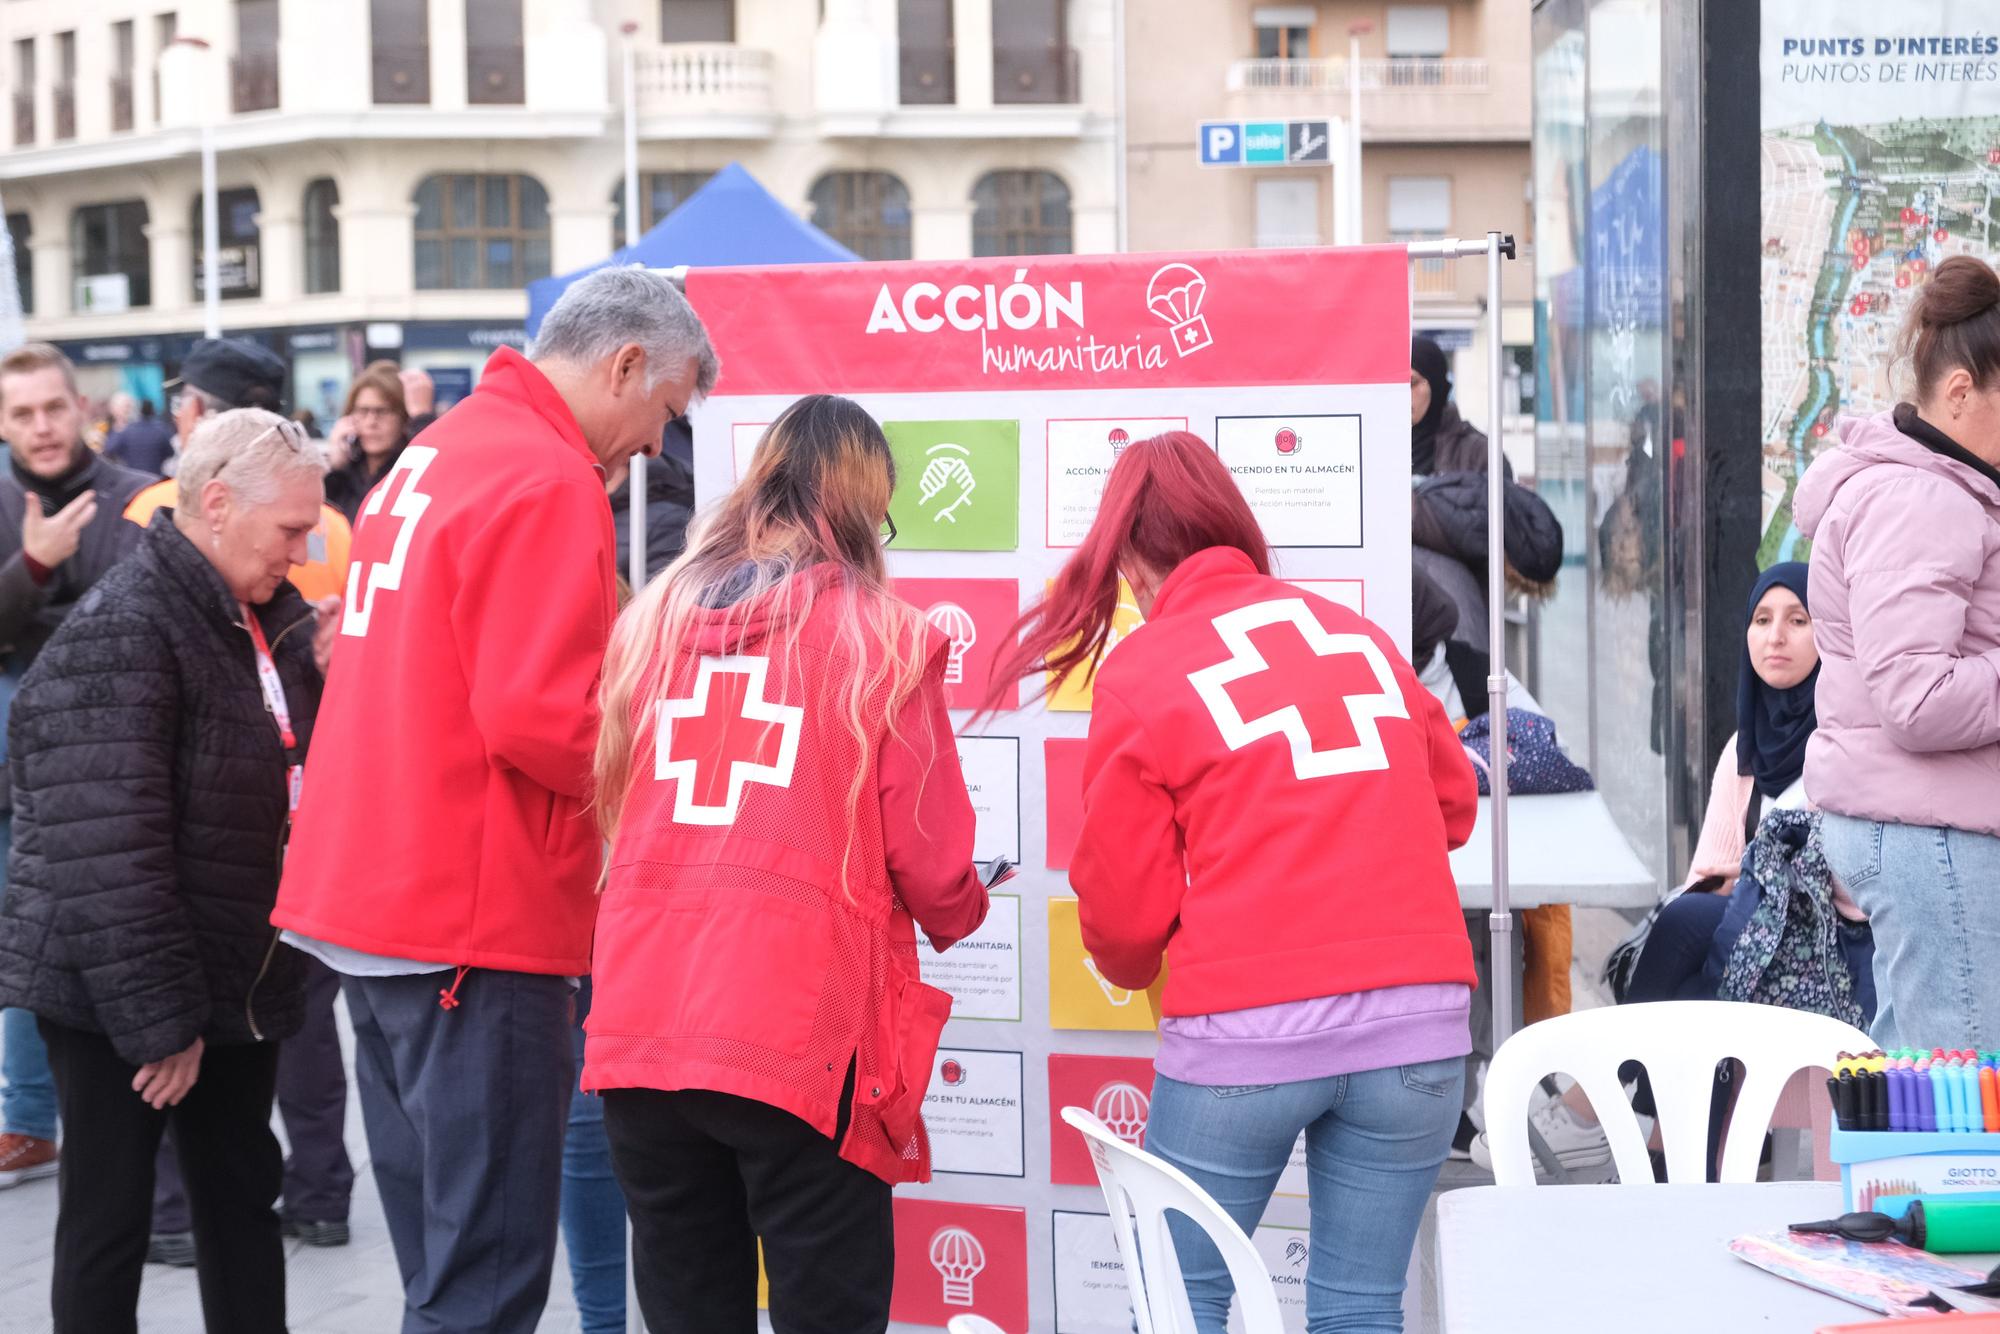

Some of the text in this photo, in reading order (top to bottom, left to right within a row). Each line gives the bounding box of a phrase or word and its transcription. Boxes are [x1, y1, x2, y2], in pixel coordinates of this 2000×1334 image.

[1783, 31, 1999, 56] PUNTS D'INTERÉS
[1782, 57, 1998, 83] PUNTOS DE INTERÉS
[1209, 128, 1235, 160] P
[865, 268, 1084, 334] ACCIÓN
[981, 328, 1168, 374] humanitaria
[1065, 466, 1101, 476] ACCIÓN
[1275, 465, 1287, 473] EN
[1290, 465, 1302, 473] TU
[1305, 463, 1355, 473] ALMACÉN!
[1294, 486, 1325, 494] material
[1285, 500, 1331, 508] Humanitaria
[955, 1097, 967, 1105] TU
[969, 1097, 1016, 1107] ALMACÉN!
[1948, 1168, 1996, 1177] GIOTTO
